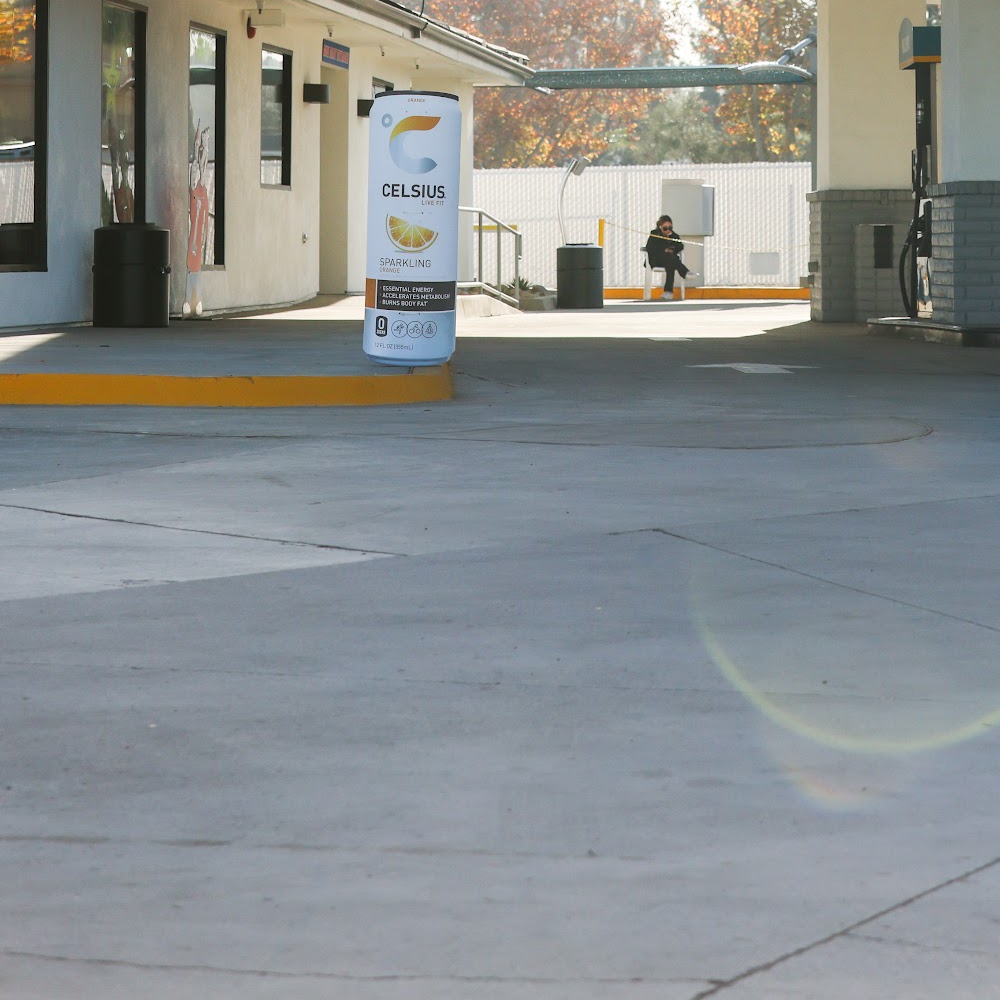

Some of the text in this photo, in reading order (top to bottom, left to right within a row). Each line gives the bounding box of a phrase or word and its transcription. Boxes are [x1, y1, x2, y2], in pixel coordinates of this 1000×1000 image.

[382, 183, 446, 199] CELSIUS
[379, 257, 432, 268] SPARKLING
[382, 285, 411, 293] ESSENTIAL
[382, 292, 420, 300] ACCELERATES
